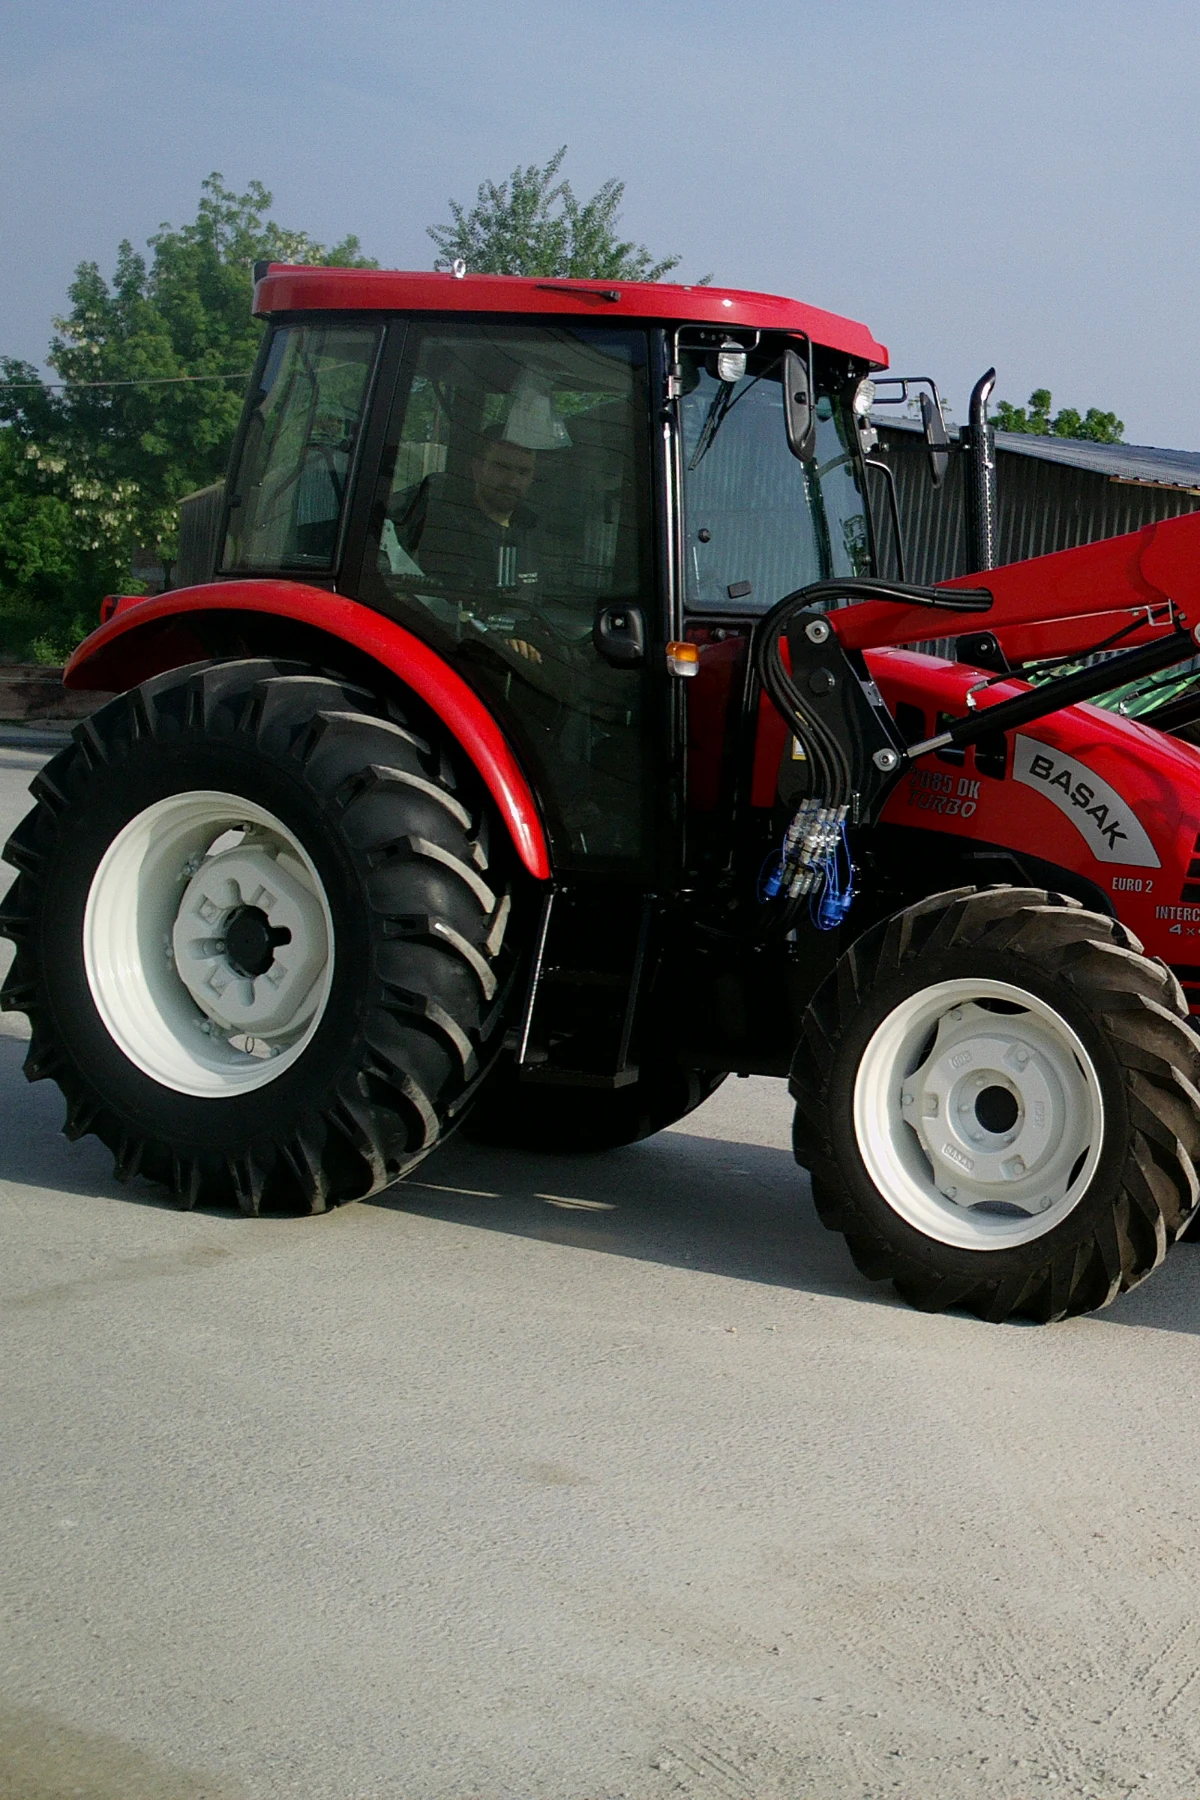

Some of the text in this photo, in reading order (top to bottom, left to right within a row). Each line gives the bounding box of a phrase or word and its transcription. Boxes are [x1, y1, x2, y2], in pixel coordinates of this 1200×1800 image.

[957, 778, 981, 799] DK
[908, 790, 977, 818] TURBO
[1028, 754, 1128, 850] BAŞAK
[1112, 877, 1153, 893] EURO 2
